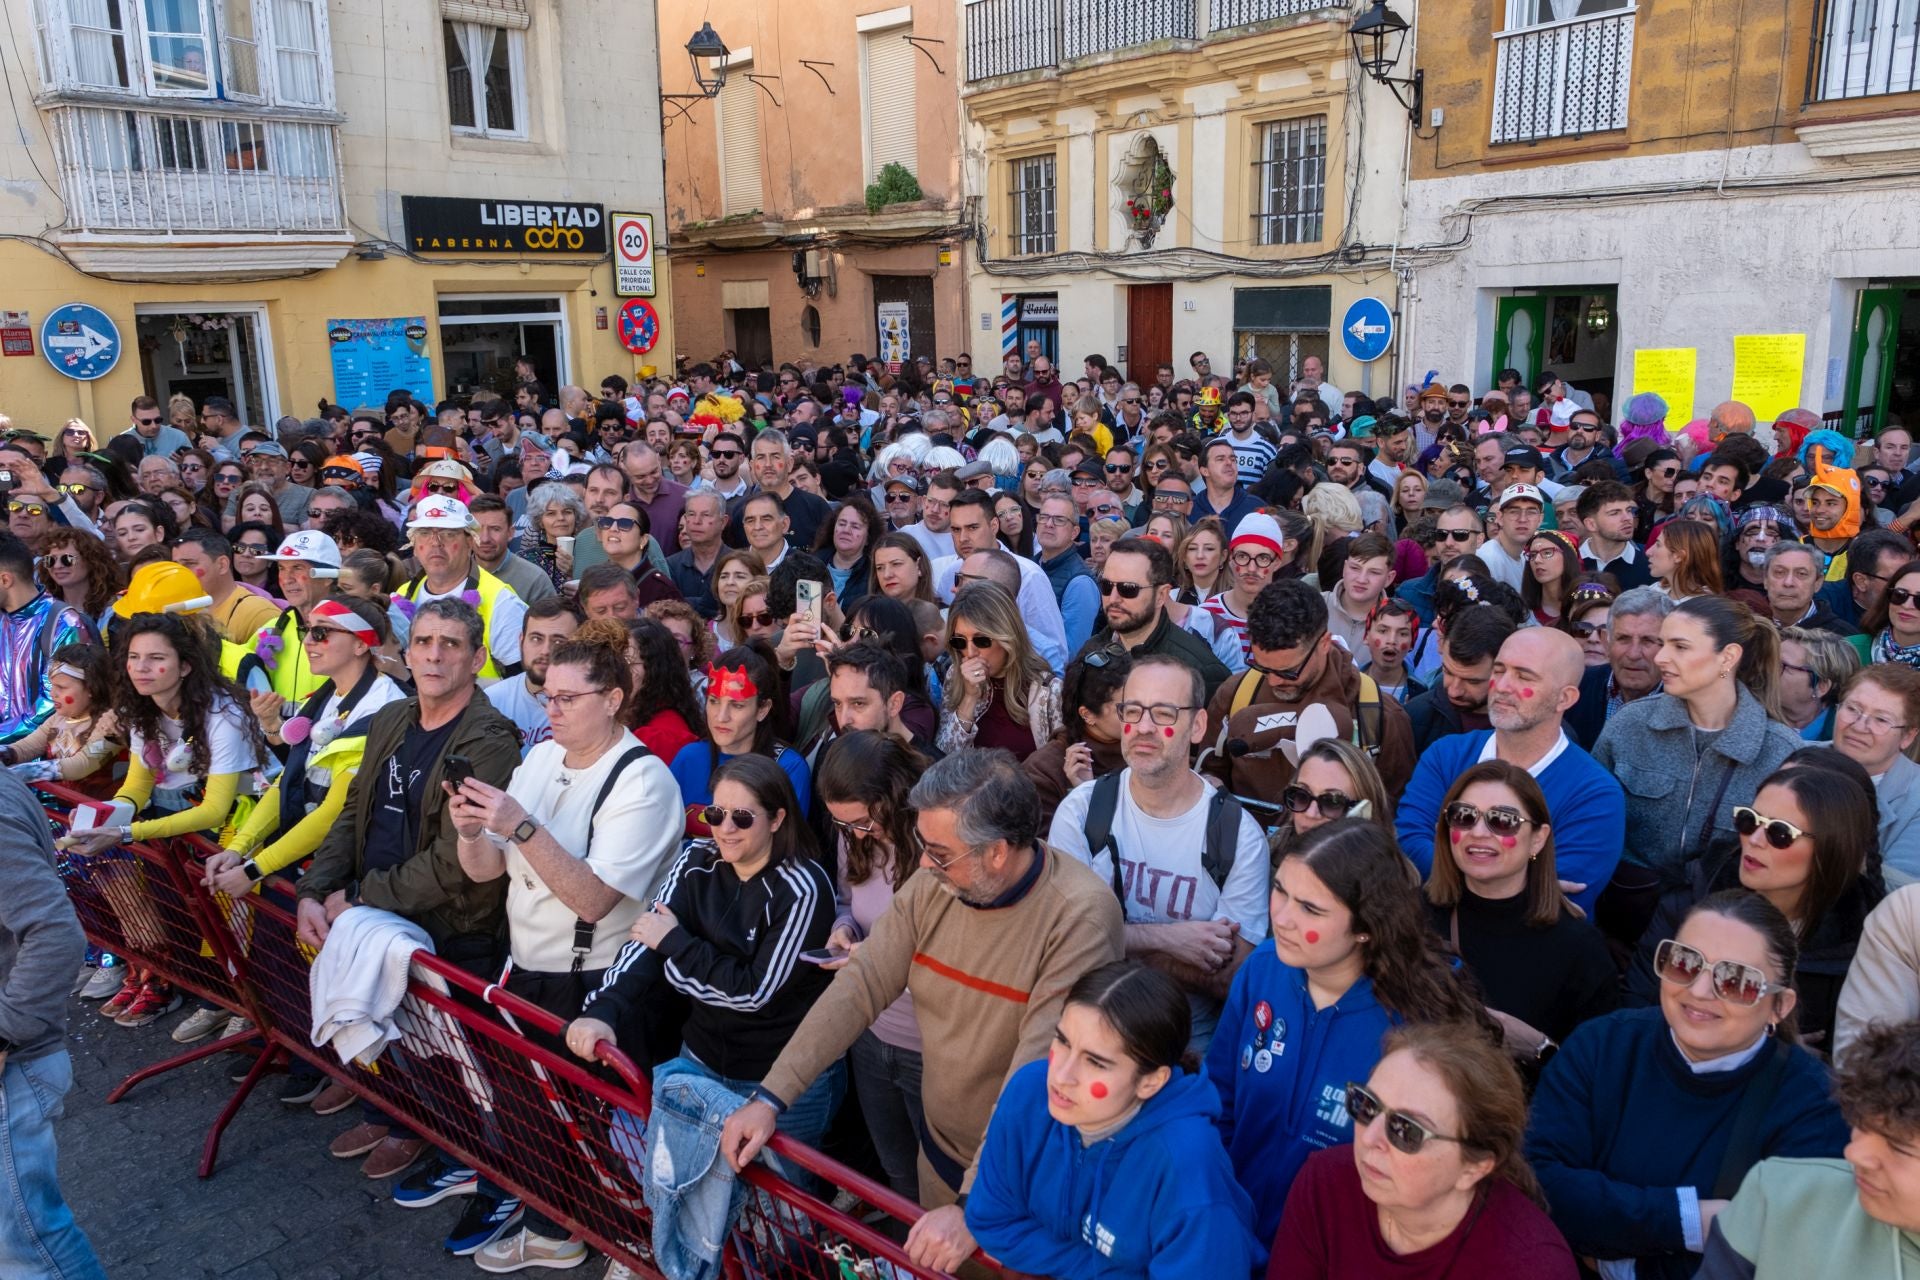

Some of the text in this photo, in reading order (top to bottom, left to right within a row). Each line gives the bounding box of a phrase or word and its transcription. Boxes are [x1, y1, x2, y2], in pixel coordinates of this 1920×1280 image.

[480, 203, 601, 228] LIBERTAD
[416, 237, 513, 249] TABERNA
[625, 234, 643, 249] 20
[619, 268, 652, 277] CALLE CON
[620, 276, 651, 285] PRIORIDAD
[621, 284, 652, 293] PEATONAL
[1184, 301, 1194, 310] 10
